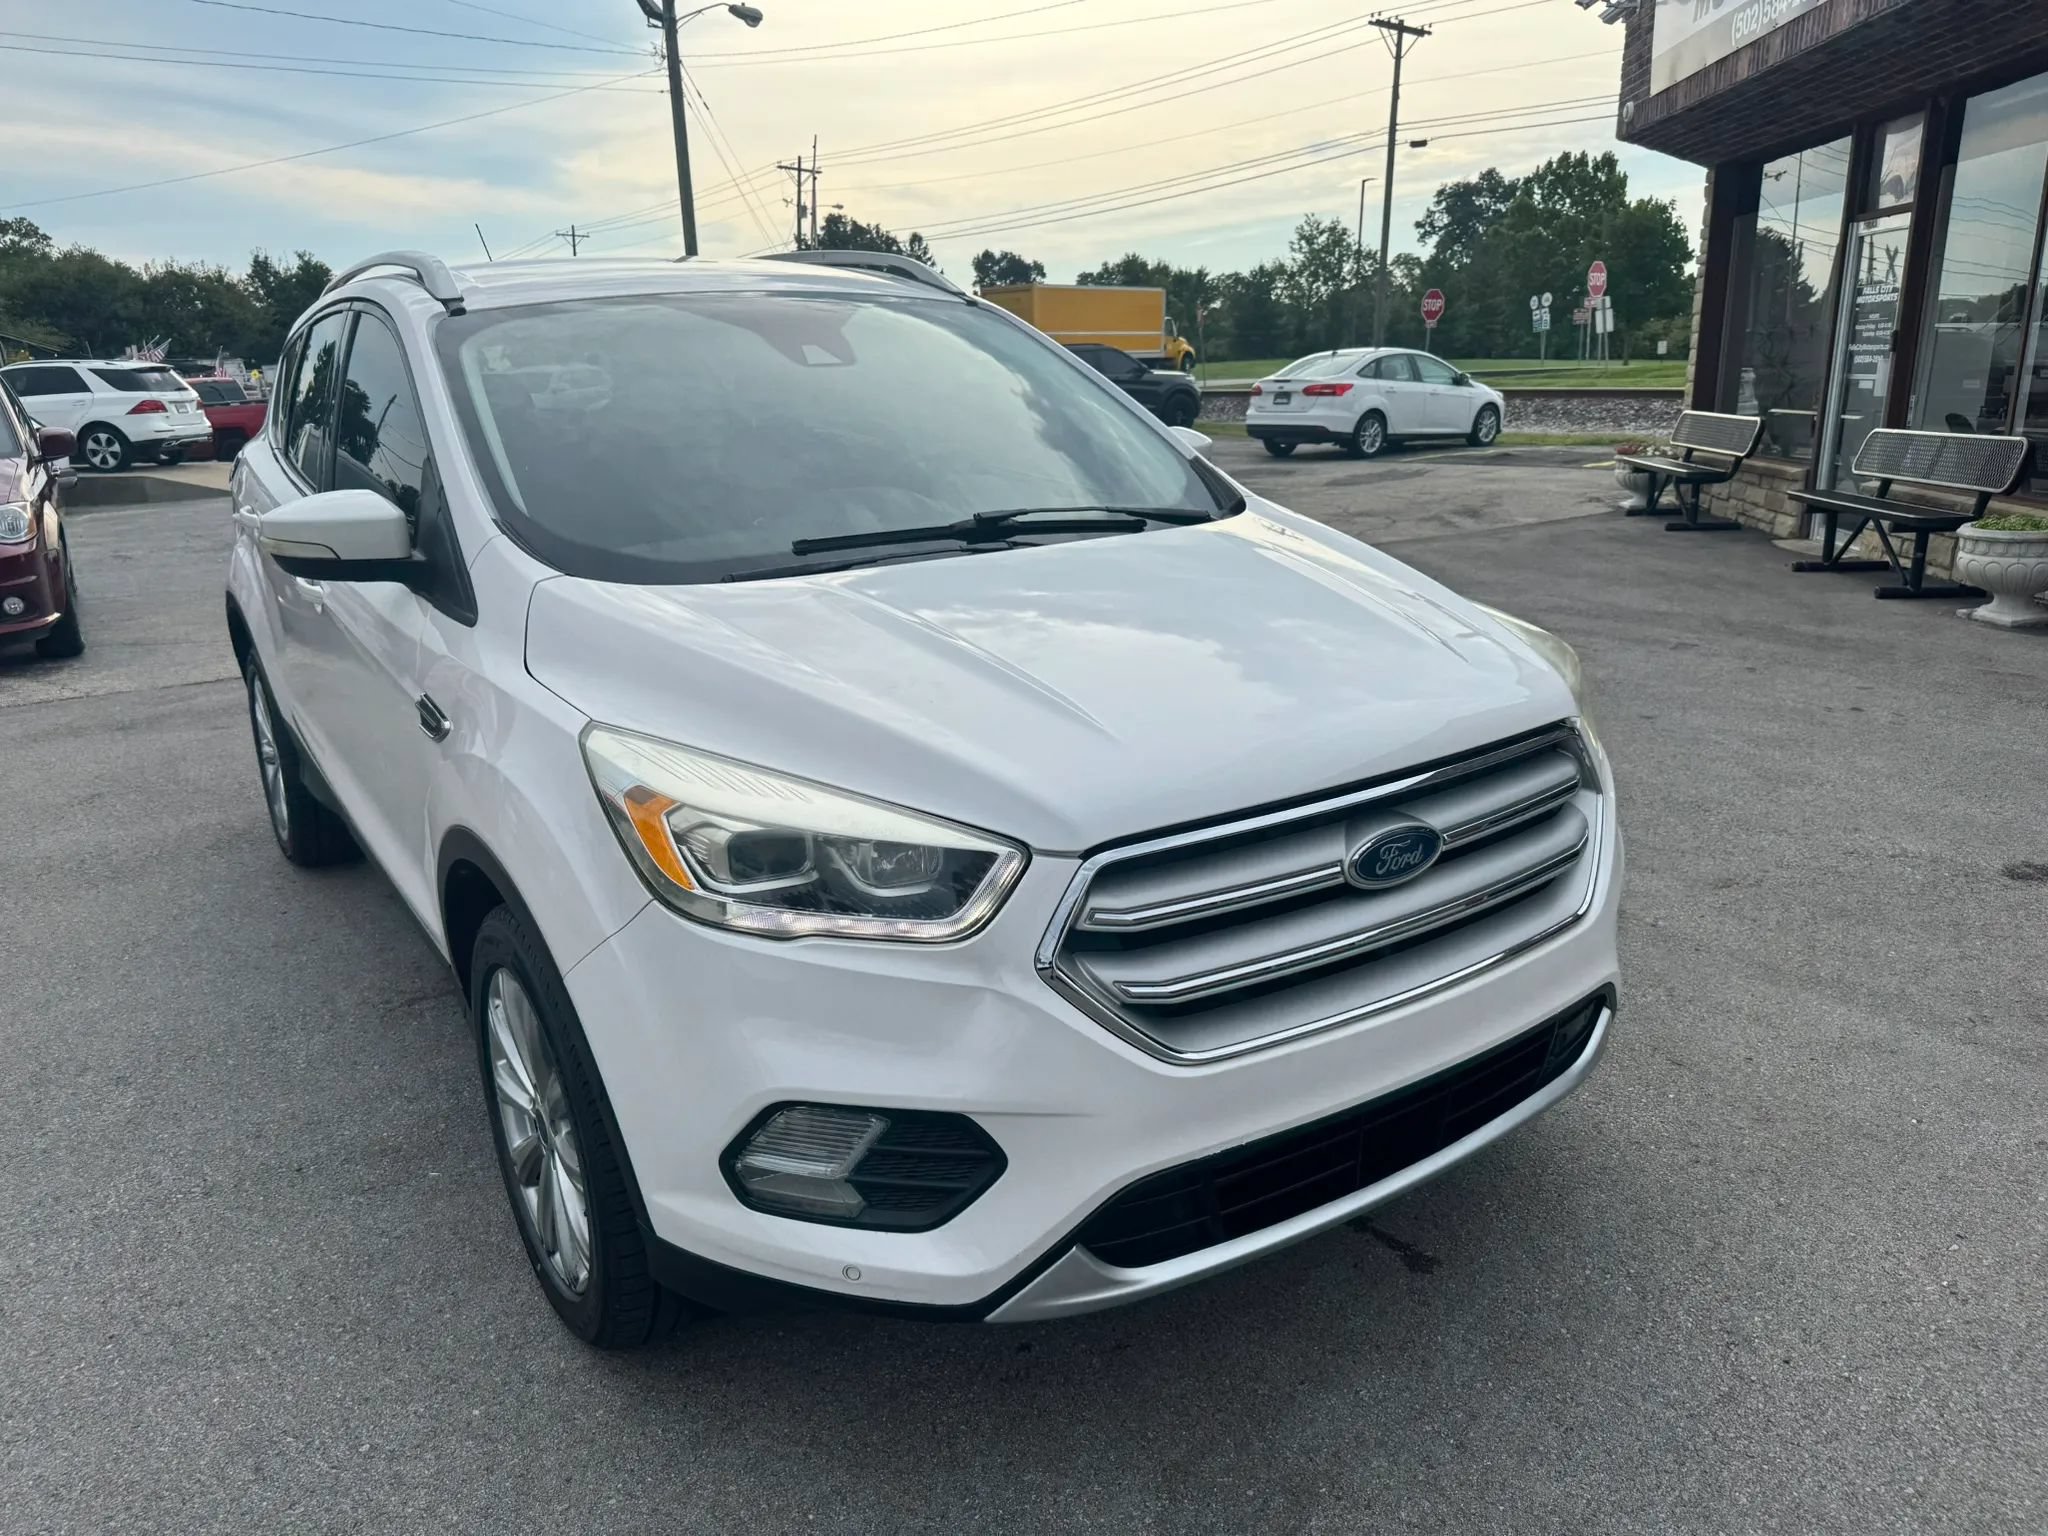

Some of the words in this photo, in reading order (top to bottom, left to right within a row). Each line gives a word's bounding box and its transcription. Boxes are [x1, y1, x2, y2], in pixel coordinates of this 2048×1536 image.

[1589, 272, 1606, 286] STOP
[1423, 298, 1443, 311] STOP
[1855, 292, 1899, 304] MOTORSPORTS
[1375, 839, 1423, 875] Ford
